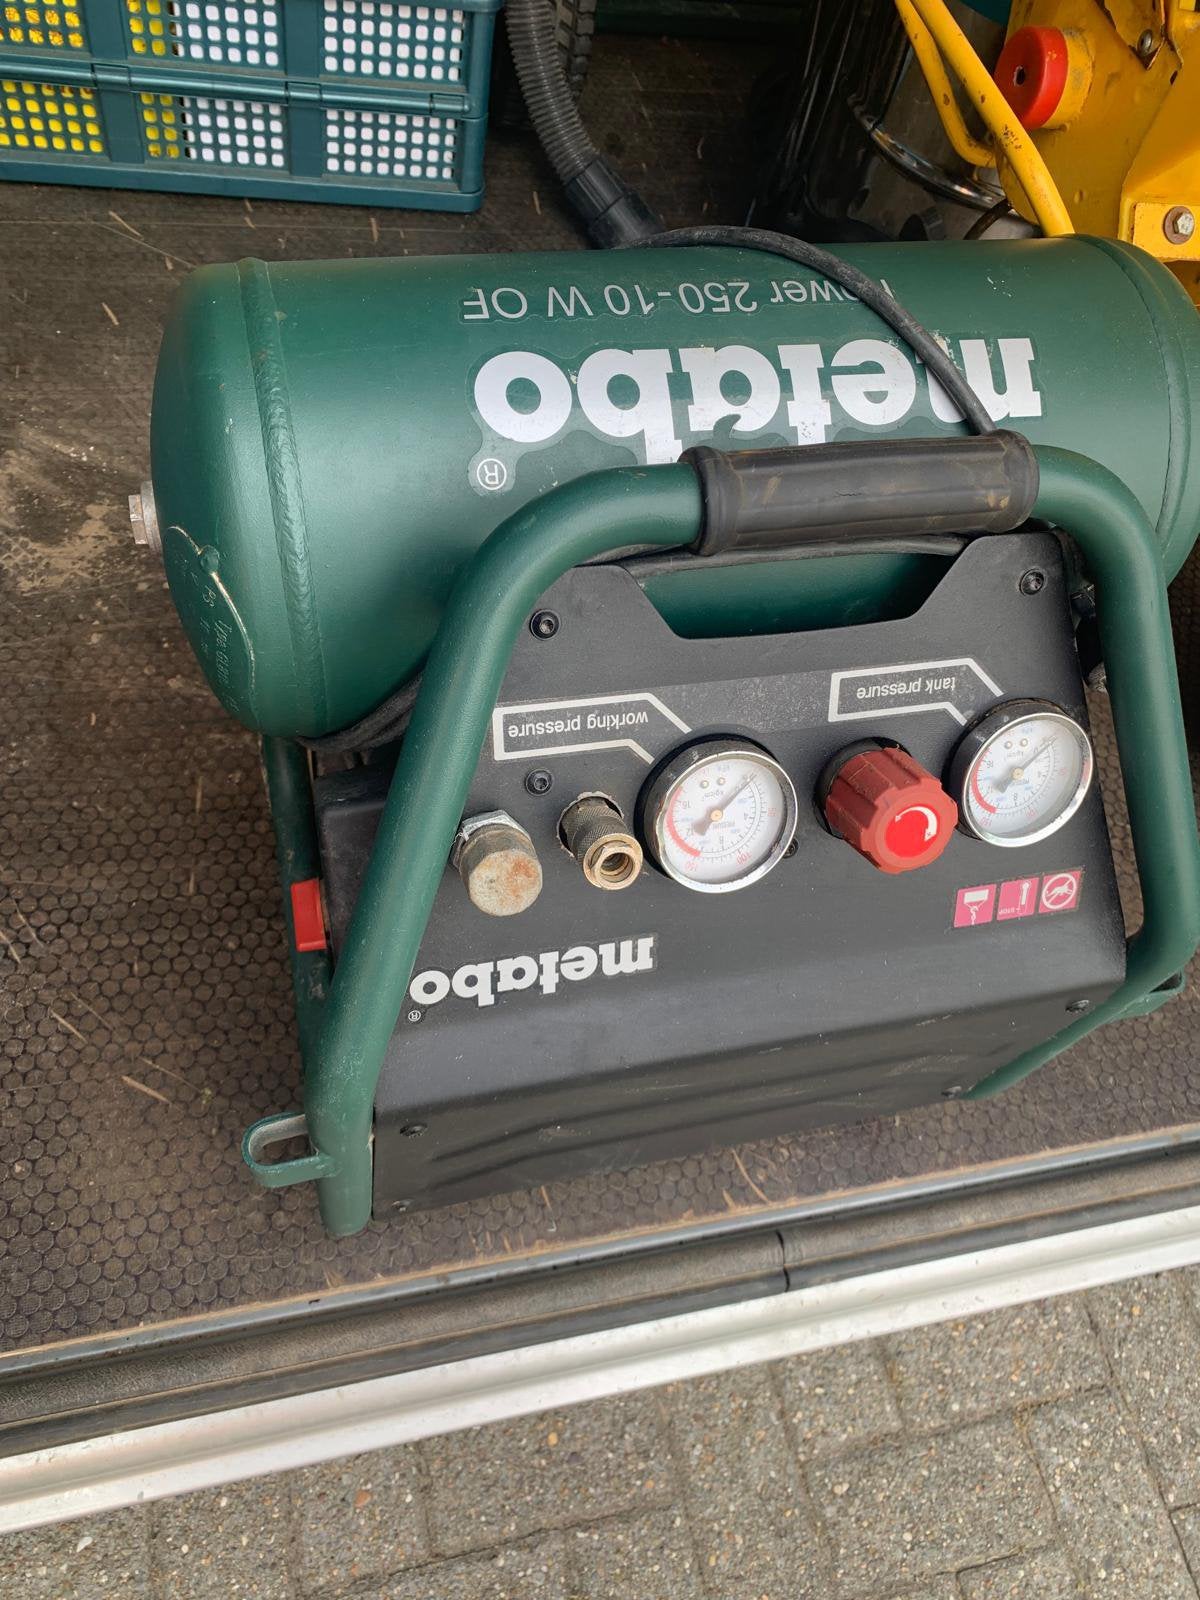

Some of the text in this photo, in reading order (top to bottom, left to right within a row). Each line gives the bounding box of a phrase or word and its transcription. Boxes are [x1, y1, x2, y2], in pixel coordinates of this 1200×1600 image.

[463, 286, 528, 319] OF
[548, 286, 593, 317] W
[604, 282, 757, 316] 250-10
[474, 338, 1042, 464] metabo
[856, 677, 956, 699] tank pressure
[508, 711, 649, 737] working pressure
[409, 936, 654, 1007] metabo
